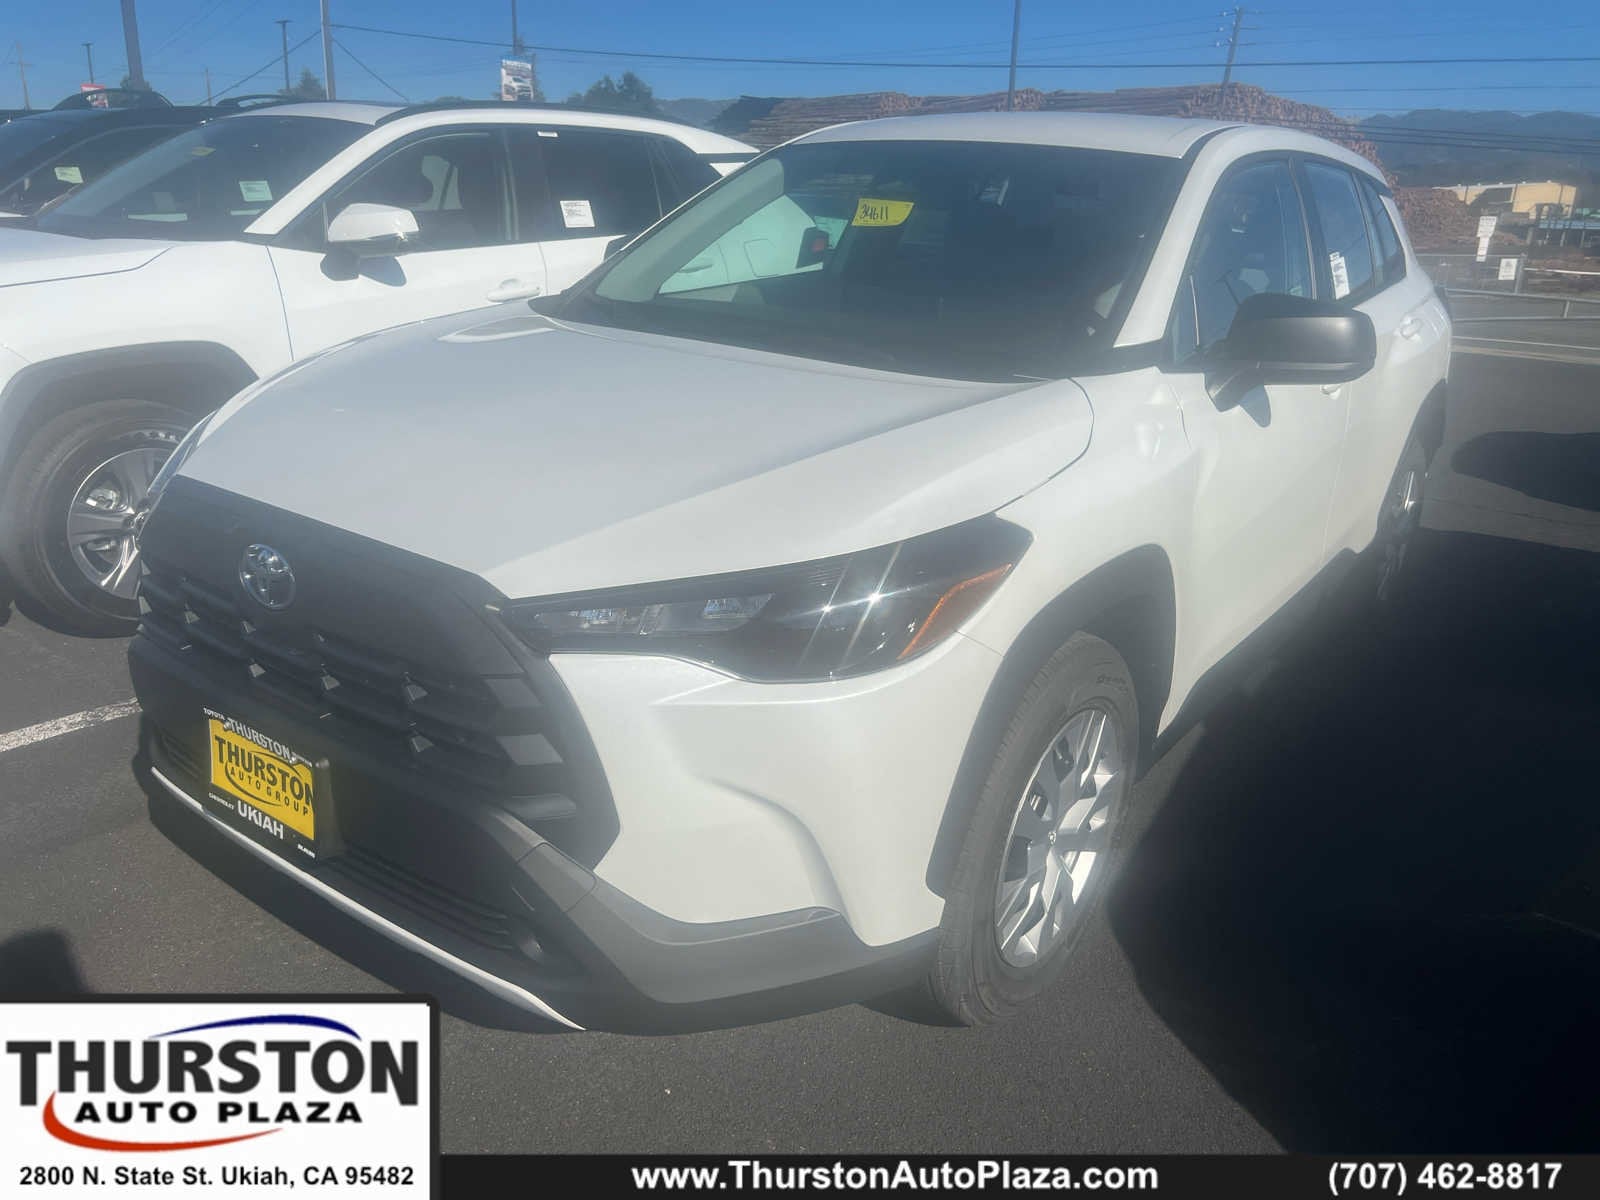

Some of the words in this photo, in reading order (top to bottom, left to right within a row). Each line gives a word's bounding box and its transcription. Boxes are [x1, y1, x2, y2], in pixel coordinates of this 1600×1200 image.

[227, 717, 291, 760] THURSTON
[214, 735, 314, 807] THURSTON
[230, 766, 261, 789] AUTO
[266, 785, 309, 816] GROUP
[237, 800, 284, 840] UKIAH
